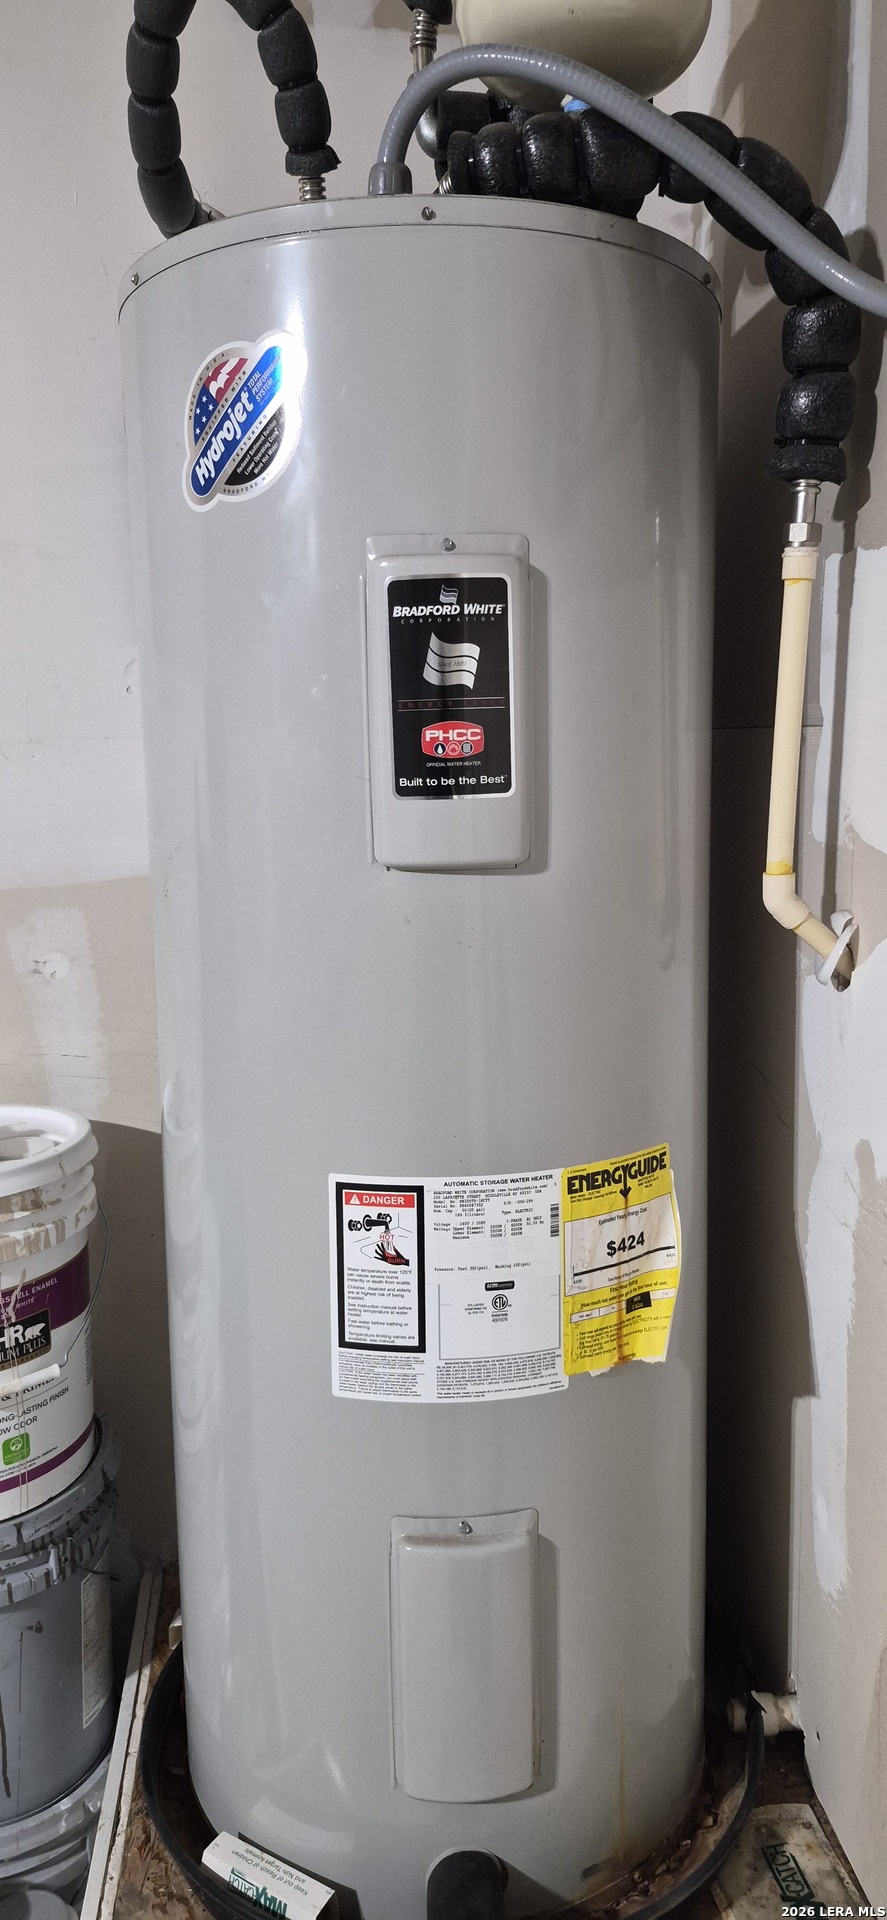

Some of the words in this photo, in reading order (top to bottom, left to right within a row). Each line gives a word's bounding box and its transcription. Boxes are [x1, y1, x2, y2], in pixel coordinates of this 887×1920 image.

[247, 370, 262, 389] TOTAL
[188, 394, 197, 420] MADE
[201, 397, 229, 442] EQUIPPED
[231, 370, 247, 392] WITH
[195, 390, 254, 487] Hydrojet
[392, 604, 460, 618] BRADFORD
[463, 603, 503, 615] WHITE
[401, 616, 495, 624] CORPORATION
[398, 700, 453, 710] ENERGY
[425, 728, 482, 742] PHCC
[399, 777, 424, 787] Built
[426, 778, 438, 786] to
[440, 776, 456, 786] be
[458, 776, 477, 784] the
[567, 1151, 667, 1195] ENERGYGUIDE
[362, 1195, 405, 1205] DANGER
[598, 1215, 616, 1225] Estimated
[627, 1209, 640, 1218] Energy
[606, 1231, 645, 1258] $424
[32, 1278, 58, 1294] ENAMEL
[23, 1336, 46, 1354] PLUS
[49, 1386, 69, 1404] FINISH
[231, 1849, 253, 1864] Children
[244, 1848, 267, 1862] Animals
[260, 1866, 277, 1879] Reach
[266, 1860, 295, 1878] Non-Target
[766, 1842, 805, 1895] CATCH
[284, 1879, 293, 1890] out
[295, 1875, 306, 1884] and
[293, 1886, 309, 1896] Keep
